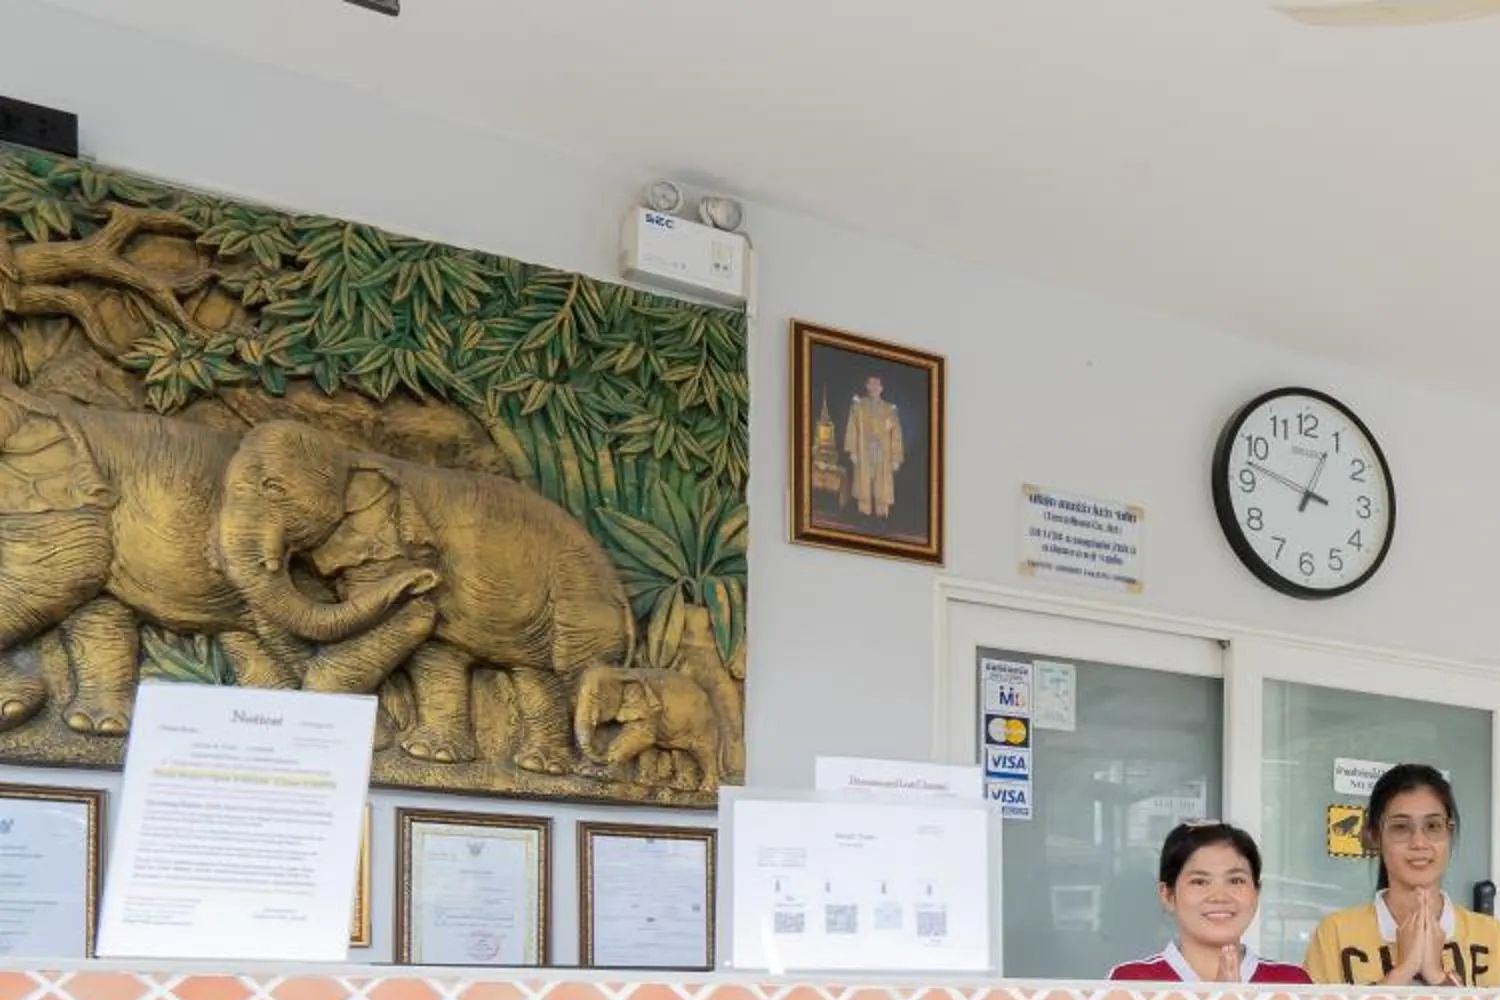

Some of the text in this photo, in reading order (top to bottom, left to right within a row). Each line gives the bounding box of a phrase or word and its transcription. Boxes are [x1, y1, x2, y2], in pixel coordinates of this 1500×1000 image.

[1269, 415, 1289, 440] 11
[1296, 412, 1319, 439] 12
[1245, 435, 1269, 461] 10
[1332, 431, 1340, 453] 1
[1239, 468, 1256, 493] 9
[1349, 458, 1366, 483] 2
[1247, 507, 1264, 531] 8
[1356, 495, 1371, 519] 3
[1271, 535, 1287, 560] 7
[1347, 529, 1363, 552] 4
[1298, 551, 1315, 577] 6
[1328, 548, 1344, 571] 5
[991, 755, 1025, 769] VISA
[991, 789, 1026, 804] VISA
